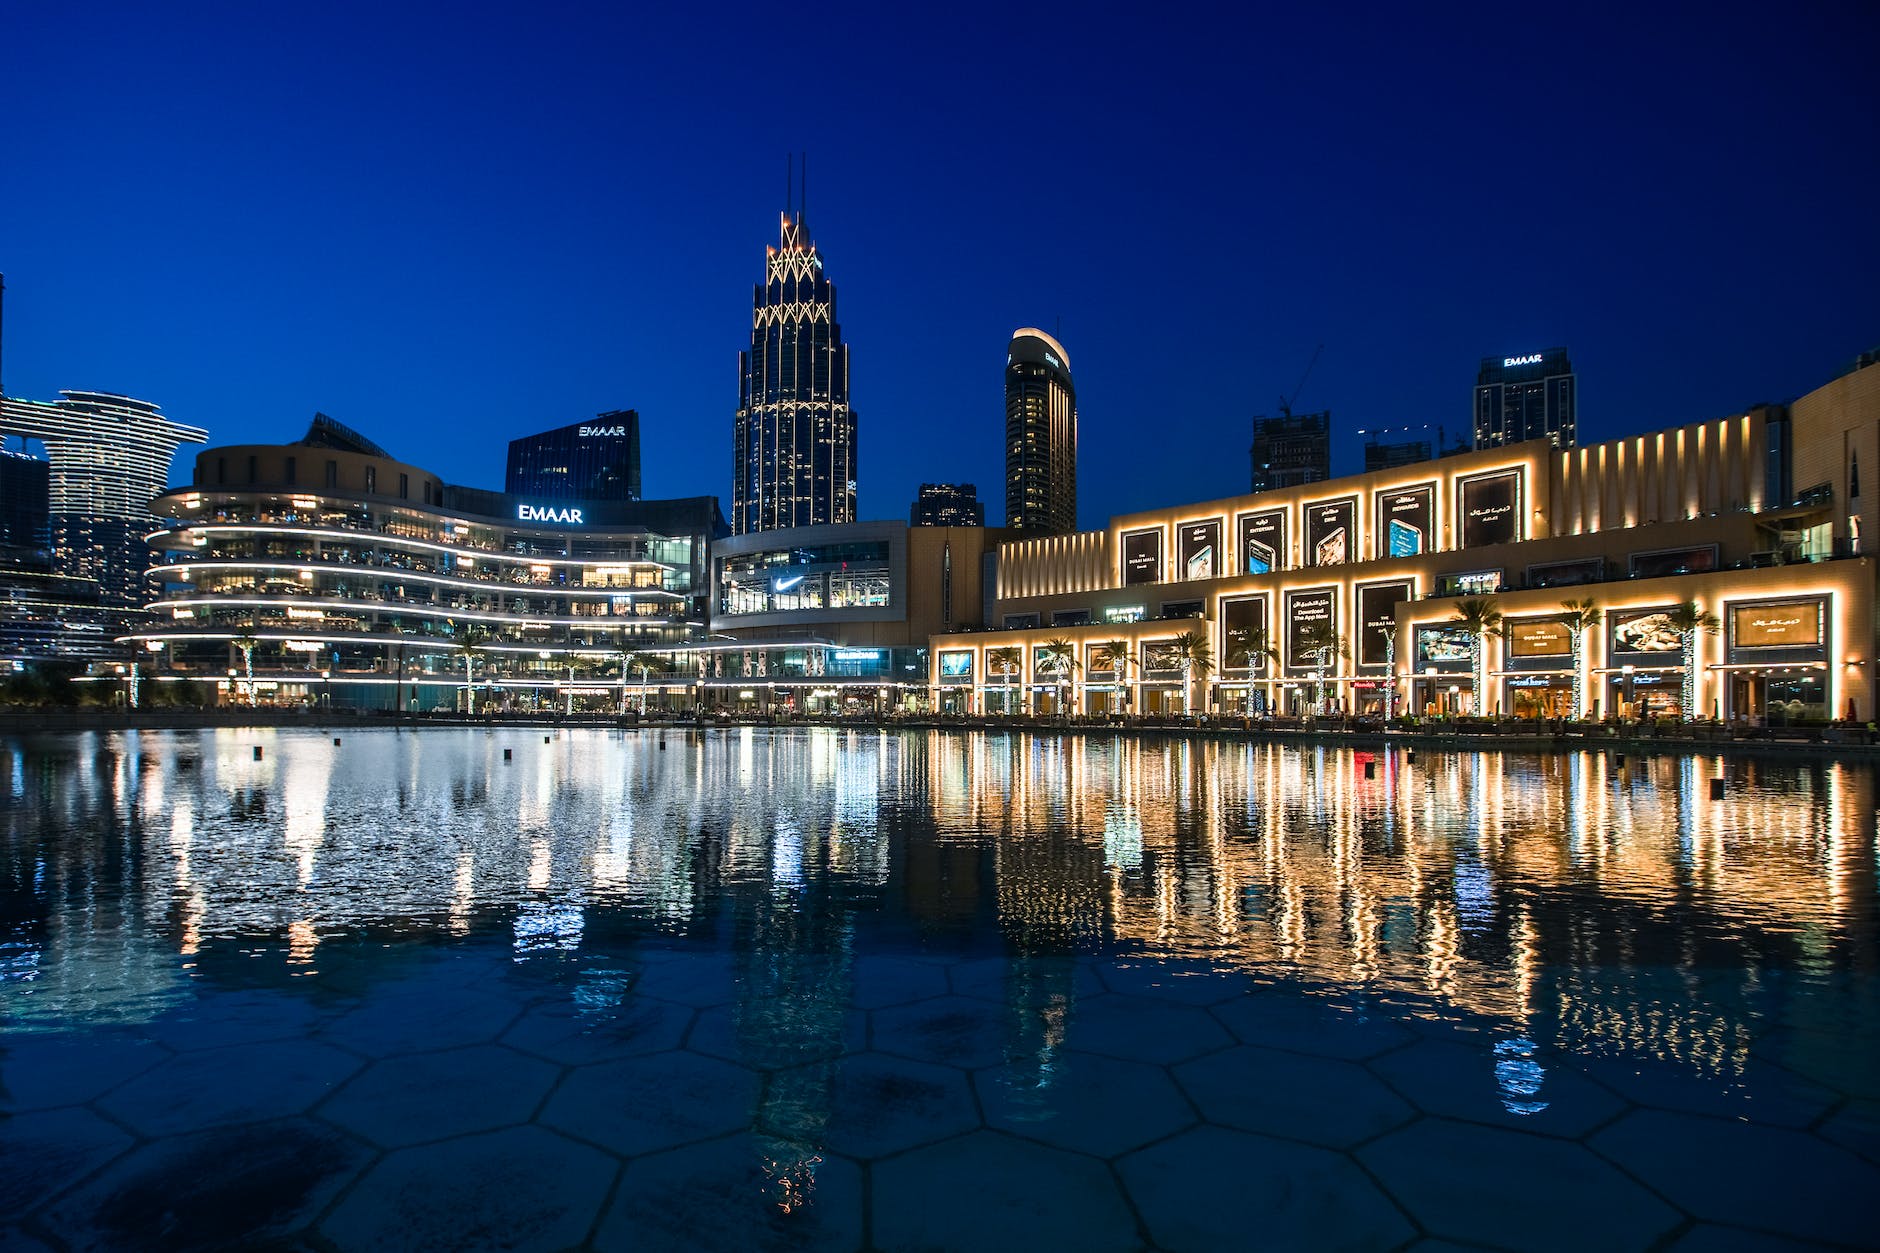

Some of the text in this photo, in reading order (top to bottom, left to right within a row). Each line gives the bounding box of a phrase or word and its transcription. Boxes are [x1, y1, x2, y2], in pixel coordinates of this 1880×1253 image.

[1503, 354, 1542, 367] EMAAR
[579, 426, 625, 436] EMAAR
[518, 504, 583, 523] EMAAR
